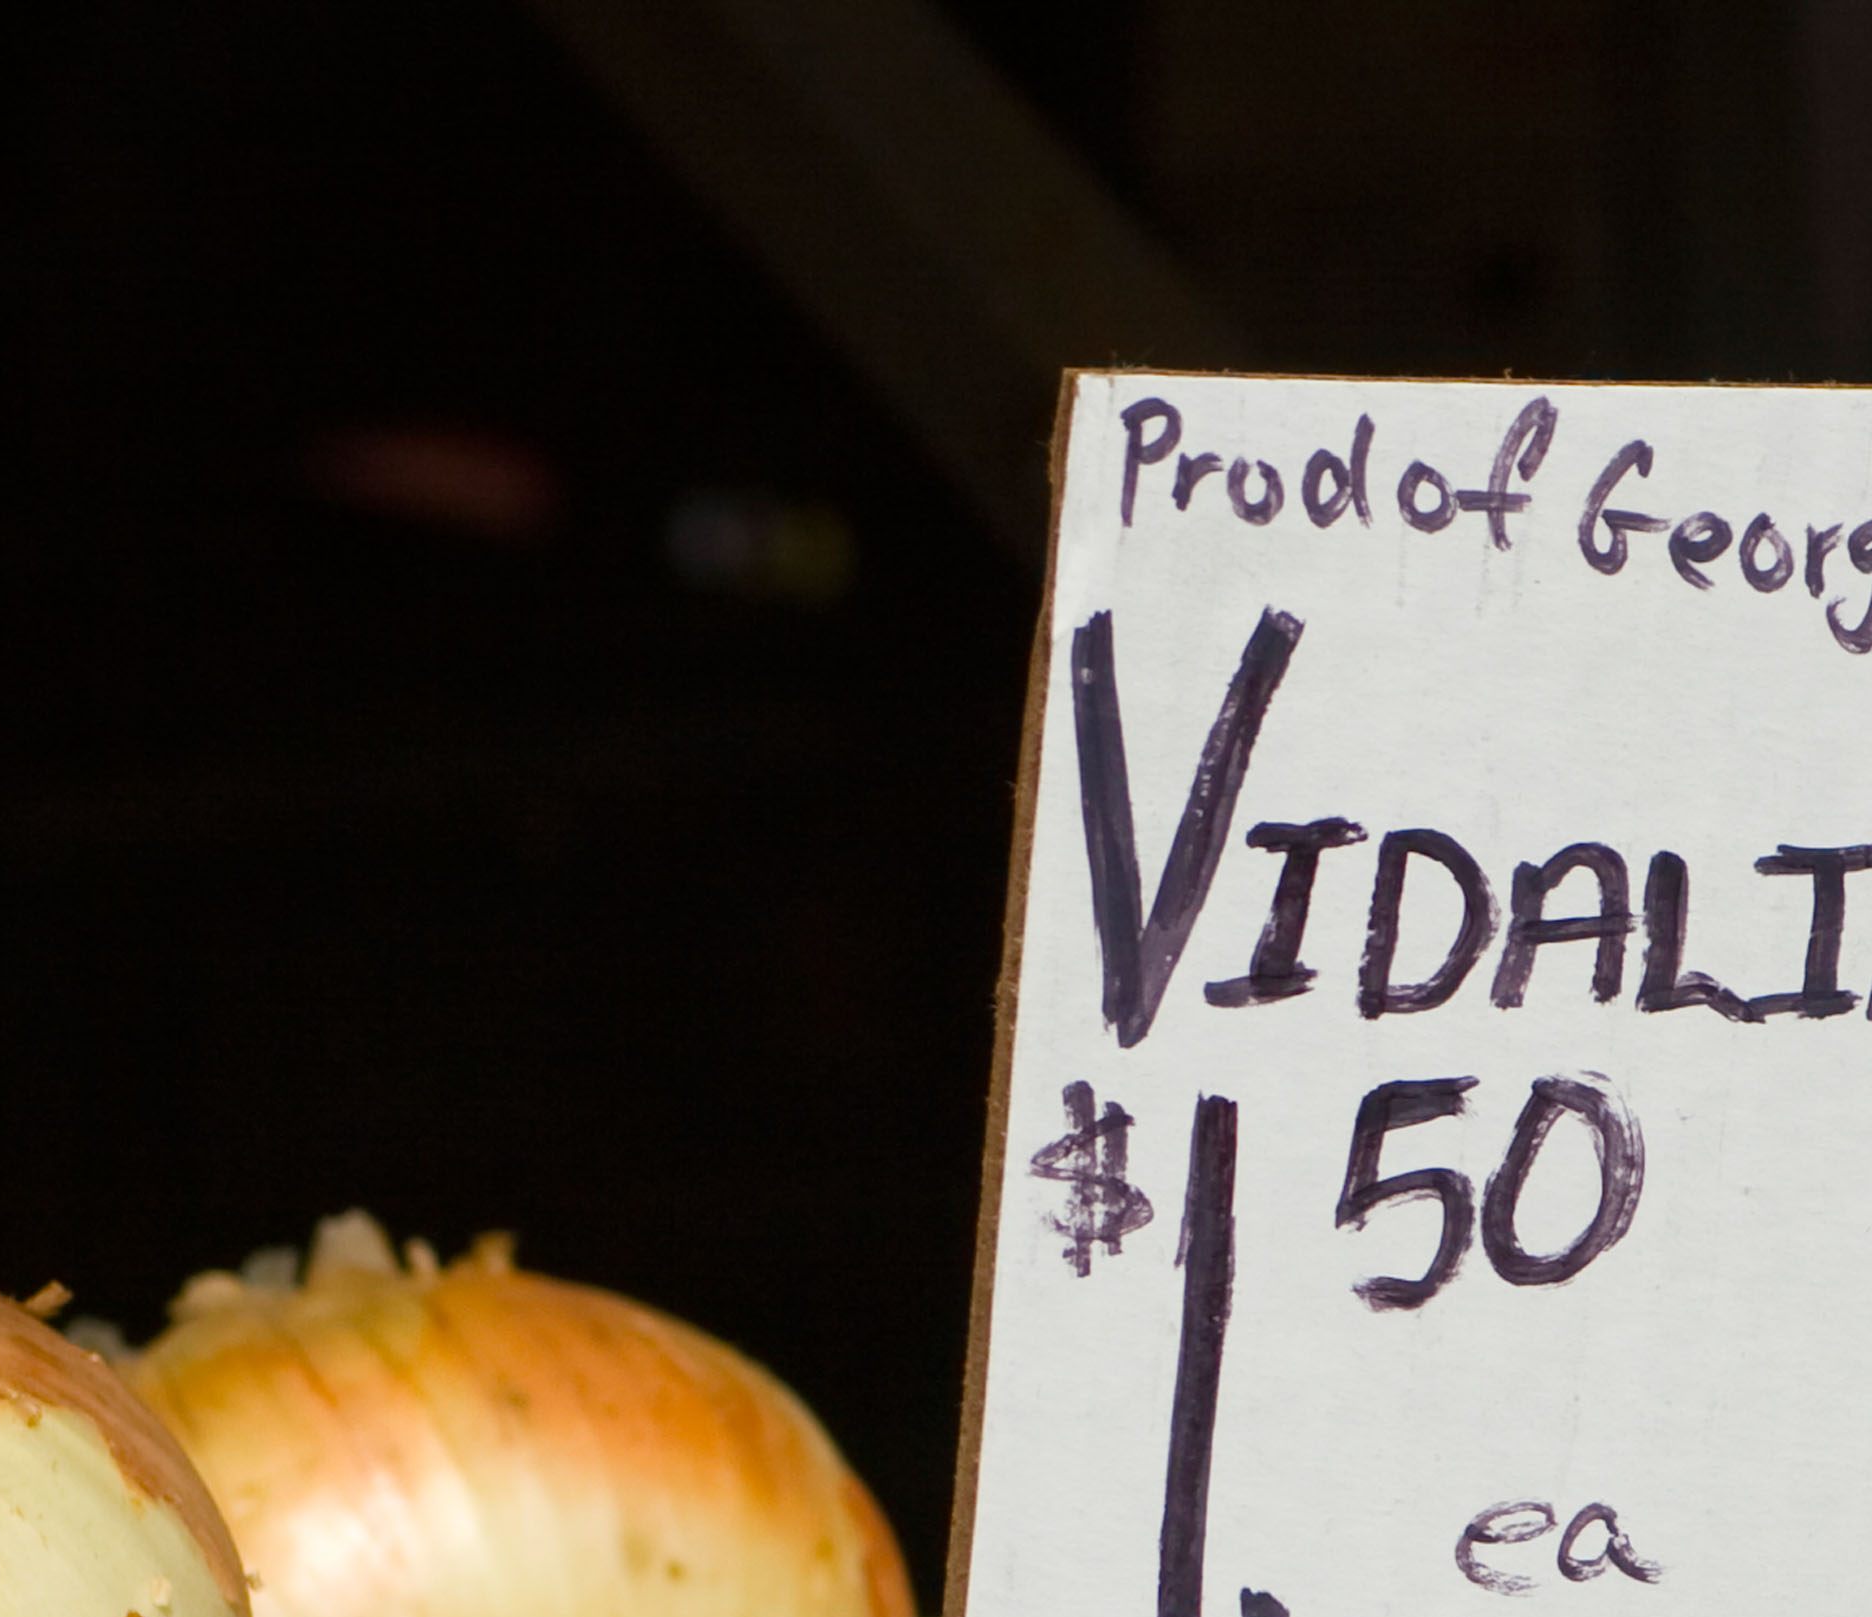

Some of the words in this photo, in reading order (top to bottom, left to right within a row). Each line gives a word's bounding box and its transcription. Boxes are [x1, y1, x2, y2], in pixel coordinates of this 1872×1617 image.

[1119, 396, 1376, 530] Prod
[1397, 397, 1557, 551] of
[1455, 1501, 1662, 1595] ea
